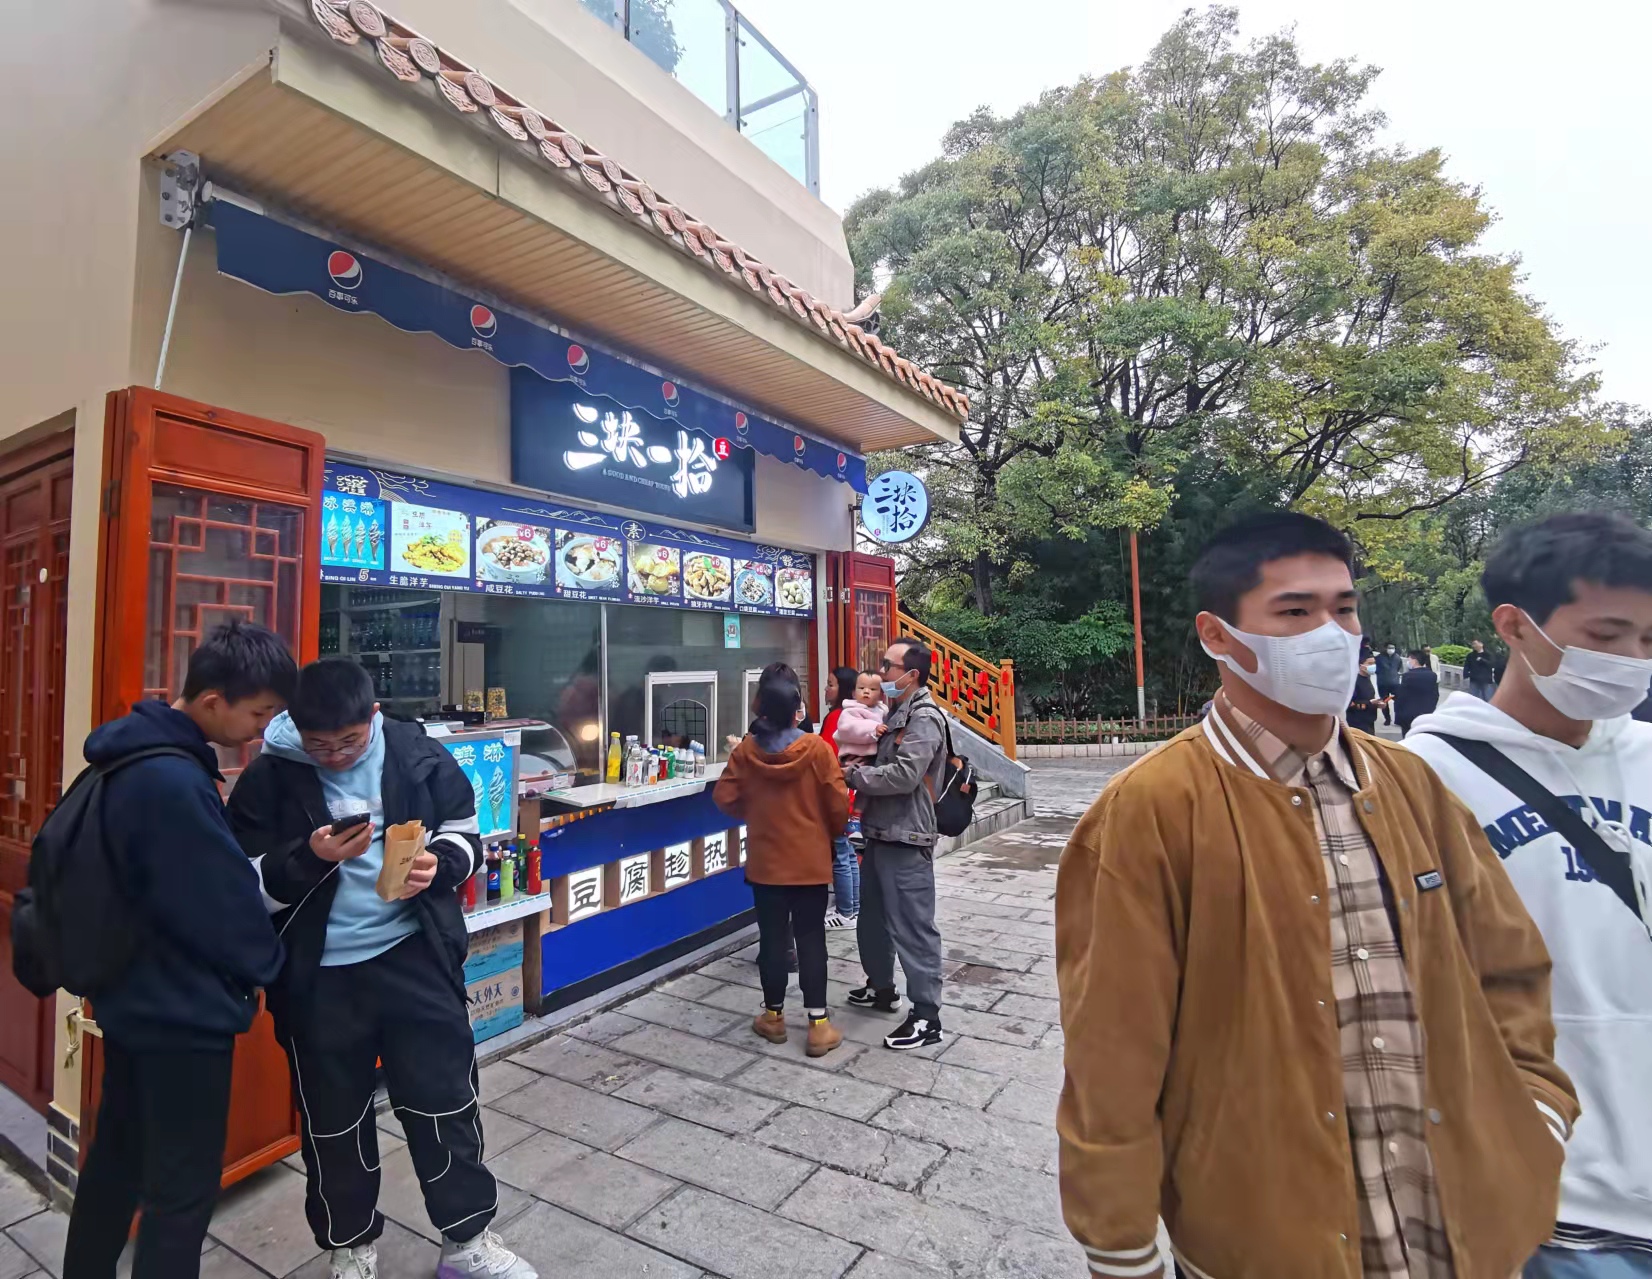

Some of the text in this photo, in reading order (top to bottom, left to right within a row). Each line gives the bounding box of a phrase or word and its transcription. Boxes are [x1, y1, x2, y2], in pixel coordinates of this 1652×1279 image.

[328, 288, 359, 306] 百事可乐
[717, 441, 729, 457] 豆
[608, 469, 625, 480] GOOD
[625, 473, 638, 483] AND
[518, 528, 532, 539] ¥6
[624, 522, 643, 539] 素
[595, 539, 607, 549] ¥6
[359, 569, 369, 581] 5
[389, 575, 429, 588] 生脆洋芋
[485, 584, 514, 594] 咸豆花
[563, 589, 587, 599] 甜豆花
